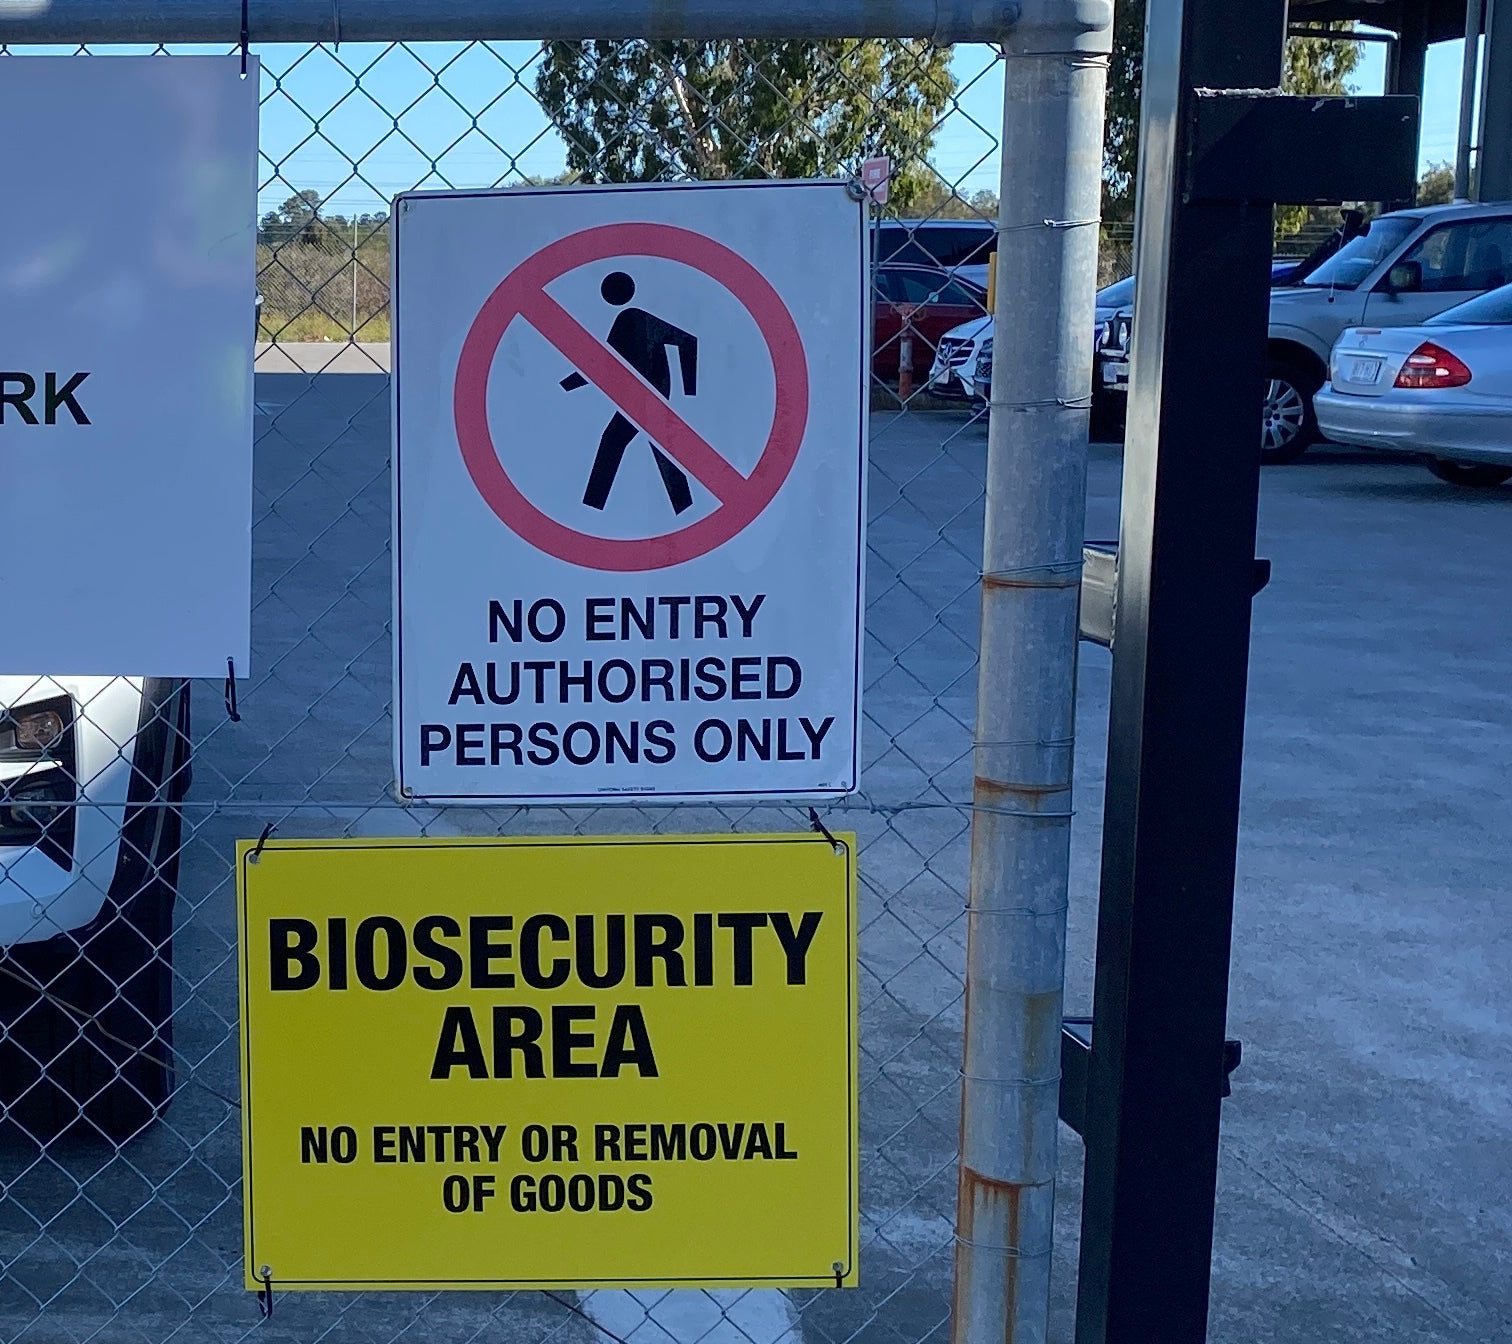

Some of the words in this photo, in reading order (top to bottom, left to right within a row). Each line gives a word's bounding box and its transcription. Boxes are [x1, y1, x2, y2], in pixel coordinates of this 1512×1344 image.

[489, 598, 566, 643] NO
[585, 594, 766, 641] ENTRY
[447, 656, 802, 705] AUTHORISED
[420, 719, 676, 767] PERSONS
[693, 717, 835, 763] ONLY
[269, 911, 823, 991] BIOSECURITY
[431, 1004, 659, 1080] AREA
[300, 1125, 357, 1164] NO
[373, 1125, 507, 1163] ENTRY
[521, 1124, 578, 1163] OR
[594, 1122, 798, 1162] REMOVAL
[443, 1174, 496, 1213] OF
[510, 1173, 653, 1213] GOODS
